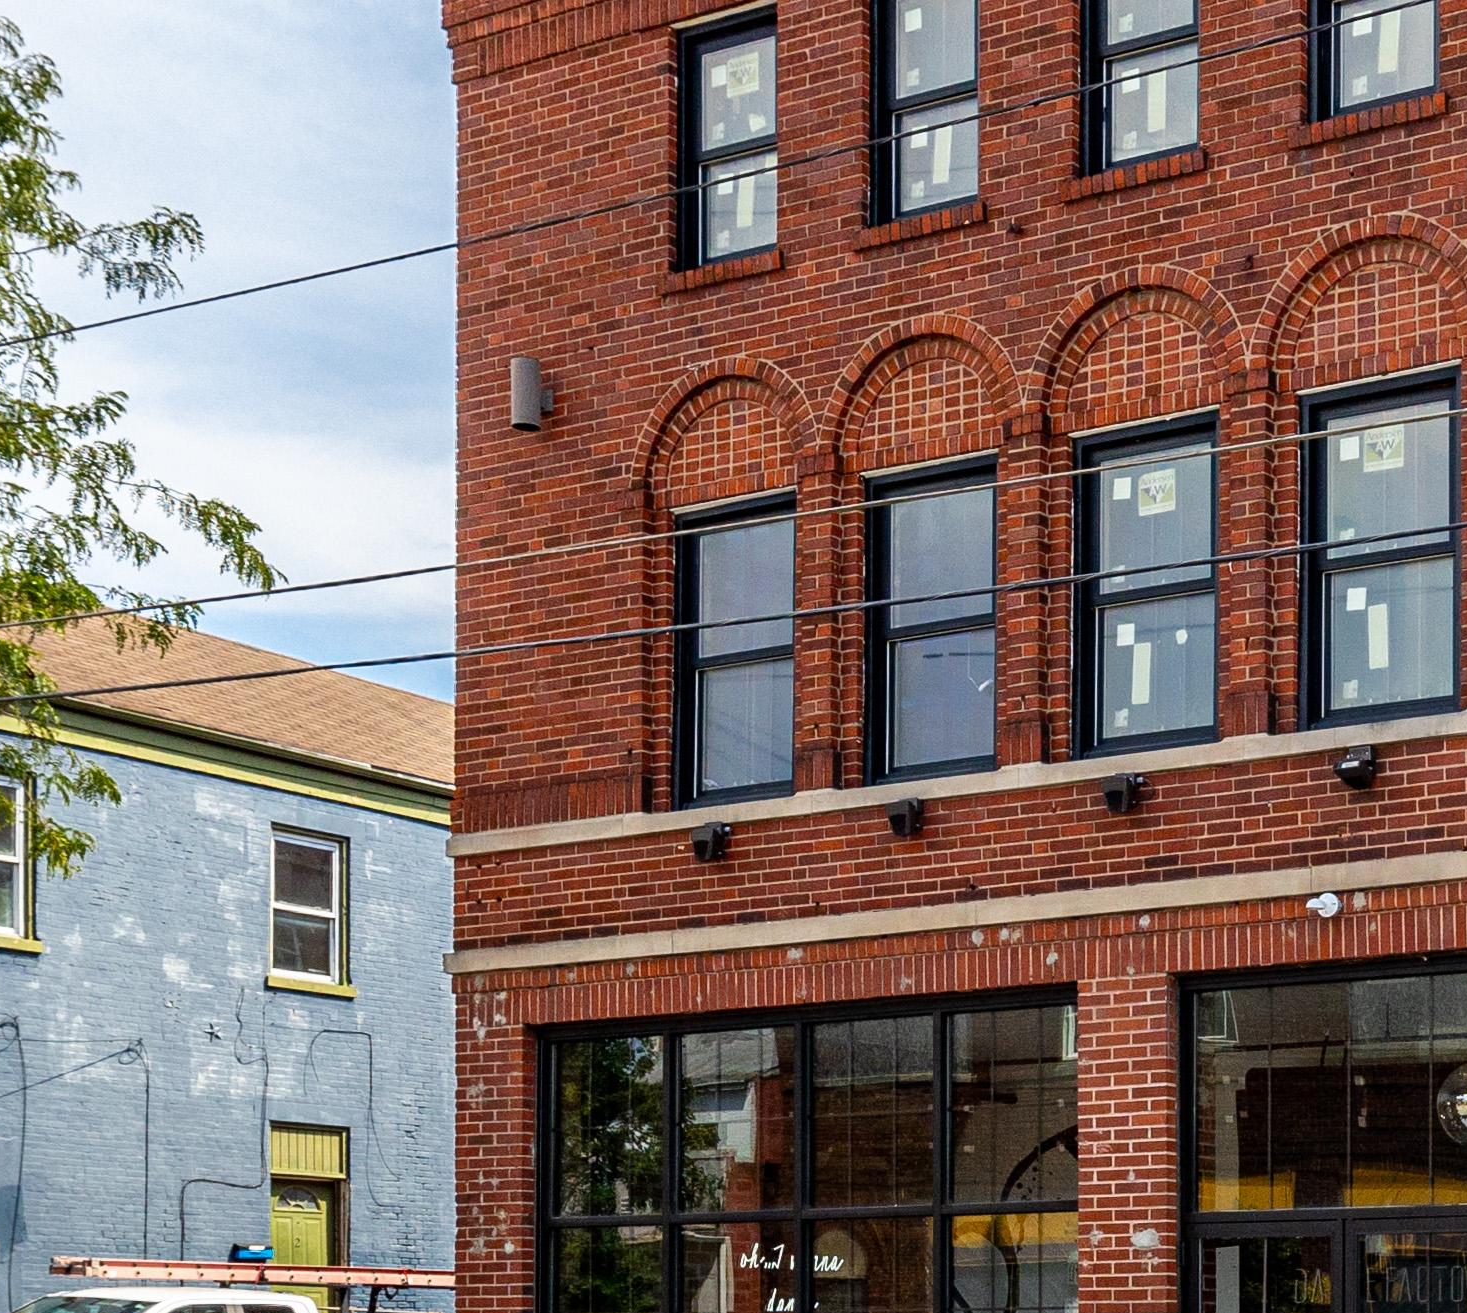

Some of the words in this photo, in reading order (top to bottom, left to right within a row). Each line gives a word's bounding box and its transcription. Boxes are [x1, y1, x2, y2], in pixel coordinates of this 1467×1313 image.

[294, 1237, 301, 1248] 2
[789, 1254, 844, 1272] nna
[1293, 1267, 1377, 1304] DAE
